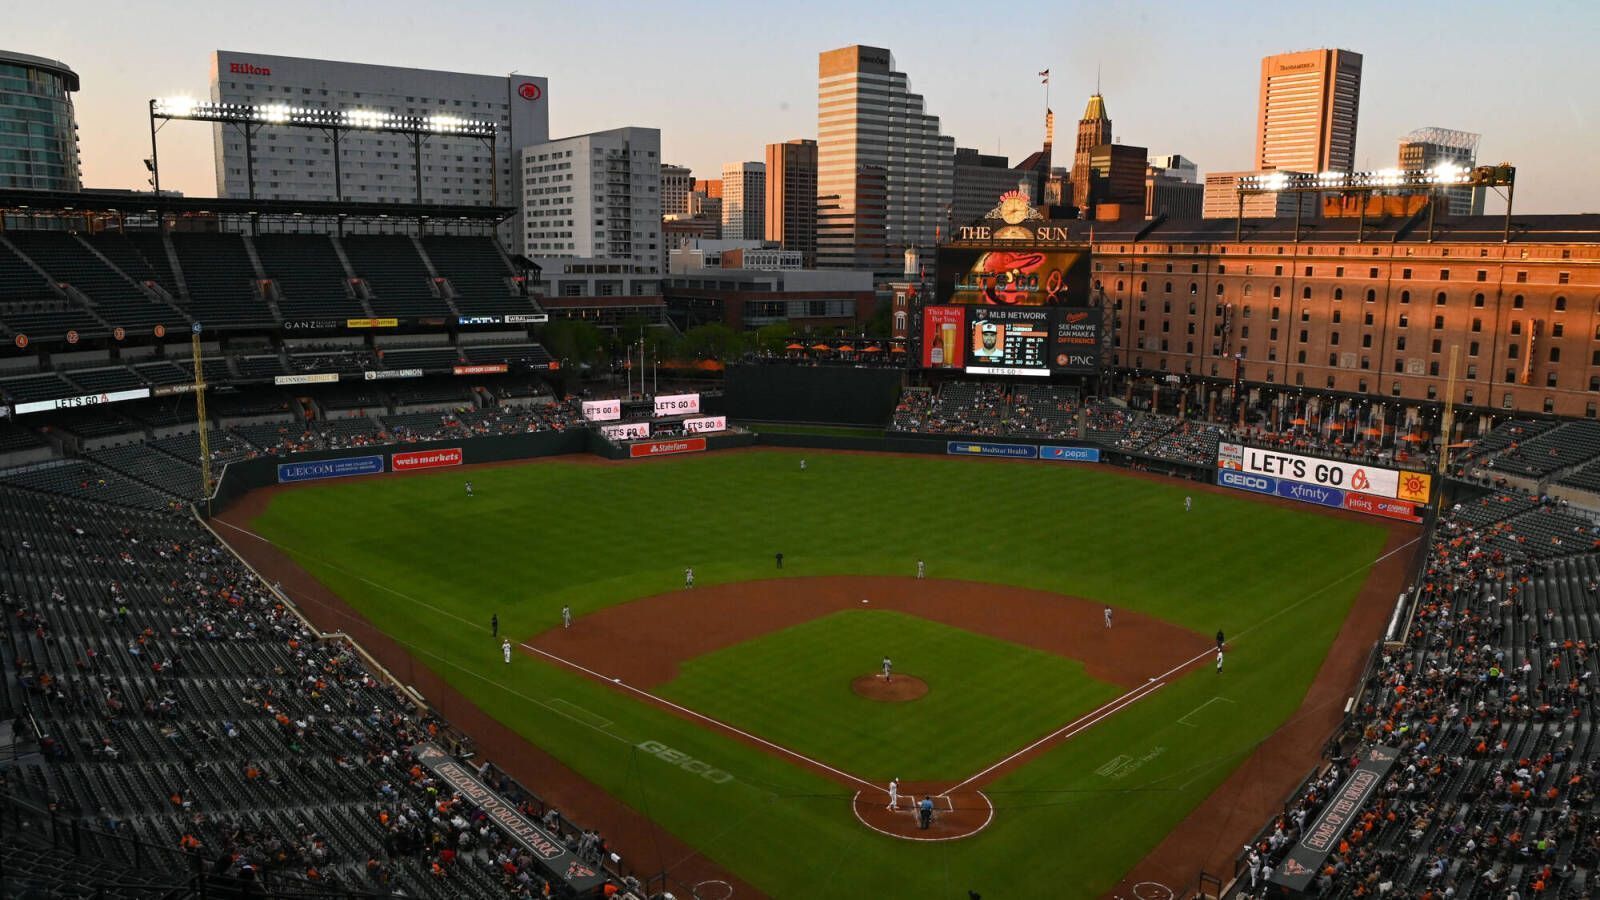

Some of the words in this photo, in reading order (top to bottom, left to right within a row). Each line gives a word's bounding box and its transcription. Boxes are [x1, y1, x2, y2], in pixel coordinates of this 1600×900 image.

[230, 62, 271, 76] Hilton
[960, 226, 991, 240] THE
[1037, 227, 1068, 240] SUN
[1015, 273, 1040, 290] GO
[989, 311, 1006, 319] MLB
[1007, 312, 1047, 320] NETWORK
[285, 321, 315, 329] GANZ
[1070, 355, 1094, 366] PNC
[400, 369, 422, 377] UNION
[55, 397, 82, 408] LET'S
[85, 396, 98, 405] GO
[655, 401, 676, 410] LET'S
[678, 400, 688, 409] GO
[583, 407, 601, 415] LET'S
[705, 421, 715, 429] GO
[397, 457, 420, 466] weis
[420, 453, 458, 464] markets
[1065, 450, 1088, 458] pepsi
[287, 465, 334, 478] LECOM
[1251, 452, 1306, 478] LET'S
[1316, 464, 1343, 486] GO
[1223, 473, 1268, 490] GEICO
[1290, 485, 1329, 502] xfinity
[1349, 498, 1373, 511] HIGH'S
[637, 740, 734, 784] GEICO
[441, 763, 487, 799] WELCOME
[479, 796, 498, 808] TO
[492, 807, 533, 840] ORIOLE
[527, 832, 559, 857] PARK
[1333, 799, 1354, 815] THE
[1326, 813, 1343, 825] OF
[1308, 822, 1336, 849] HOME
